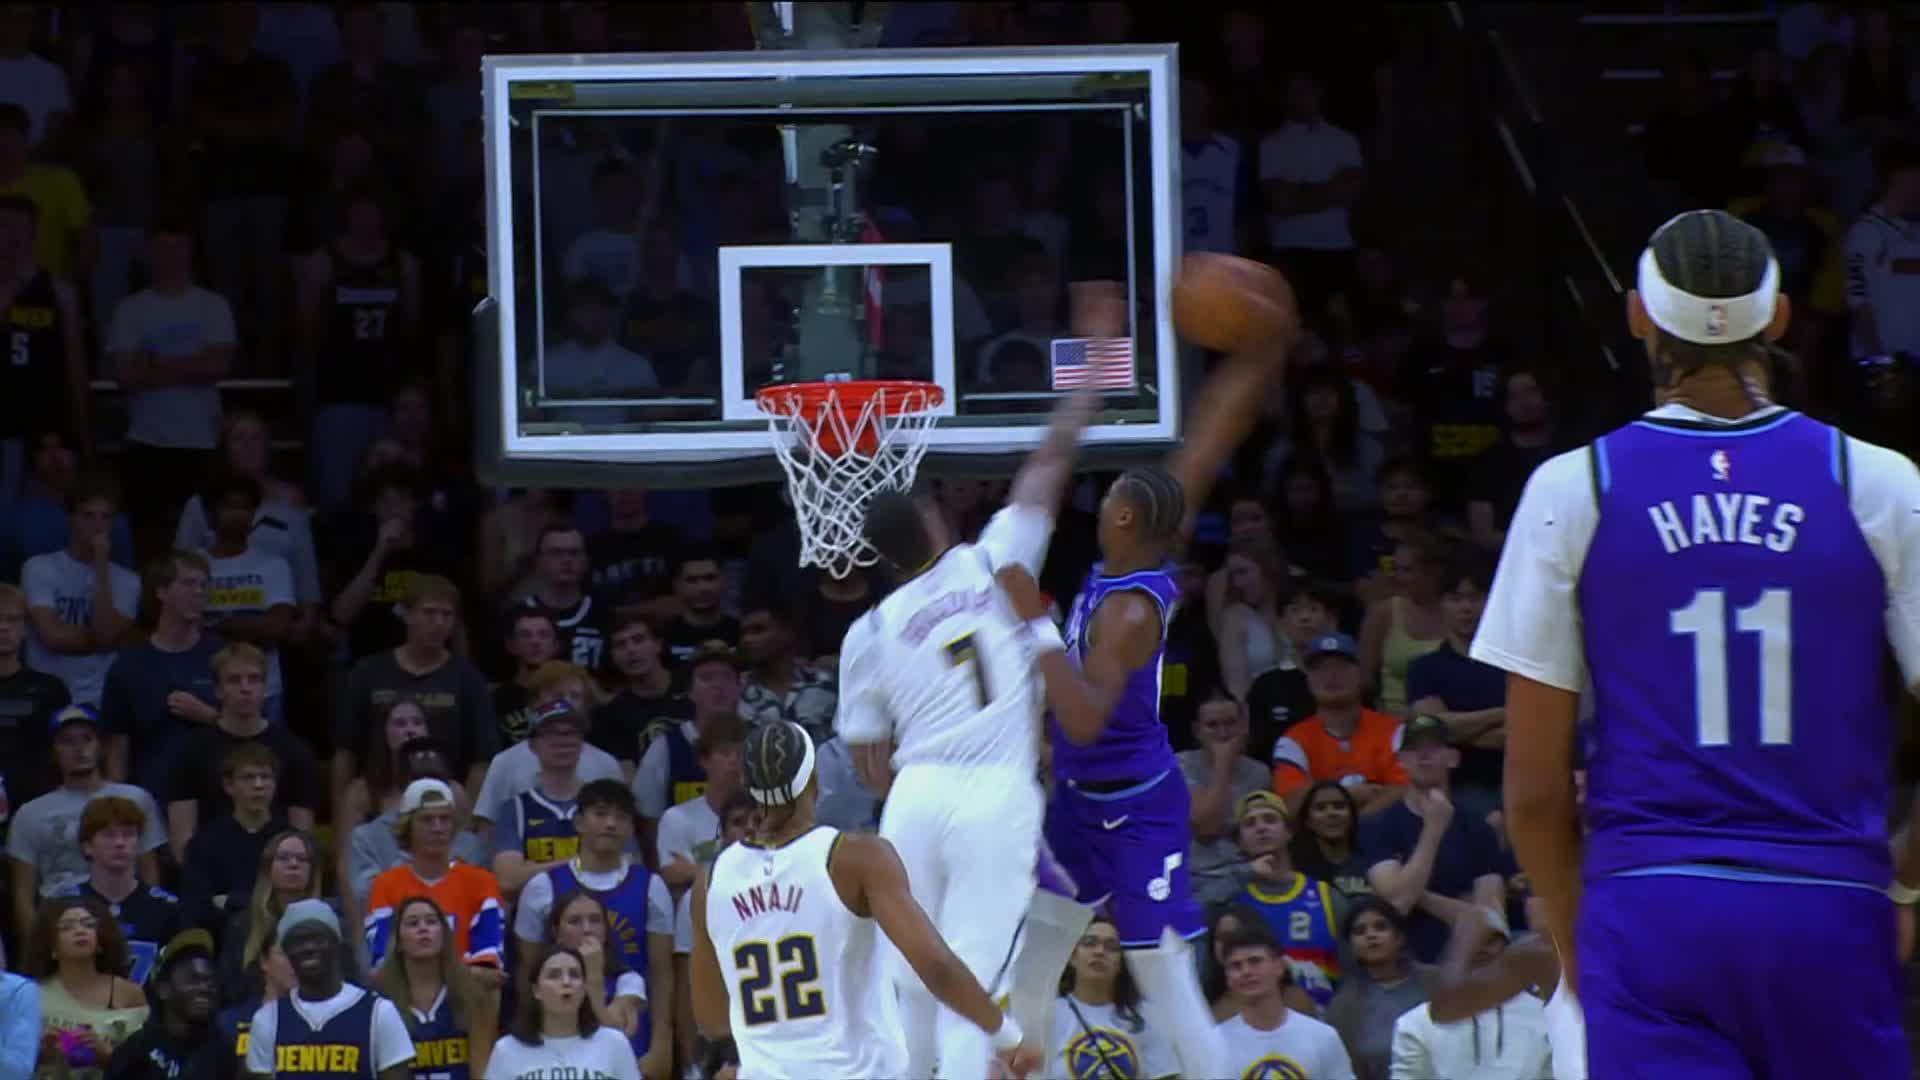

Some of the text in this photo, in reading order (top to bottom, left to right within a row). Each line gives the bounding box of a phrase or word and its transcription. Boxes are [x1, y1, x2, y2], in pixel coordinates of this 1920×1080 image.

[1648, 492, 1806, 554] HAYES
[571, 636, 605, 669] 27
[1668, 588, 1793, 747] 11
[732, 882, 803, 922] NNAJI
[1289, 911, 1312, 942] 2
[734, 932, 826, 1026] 22
